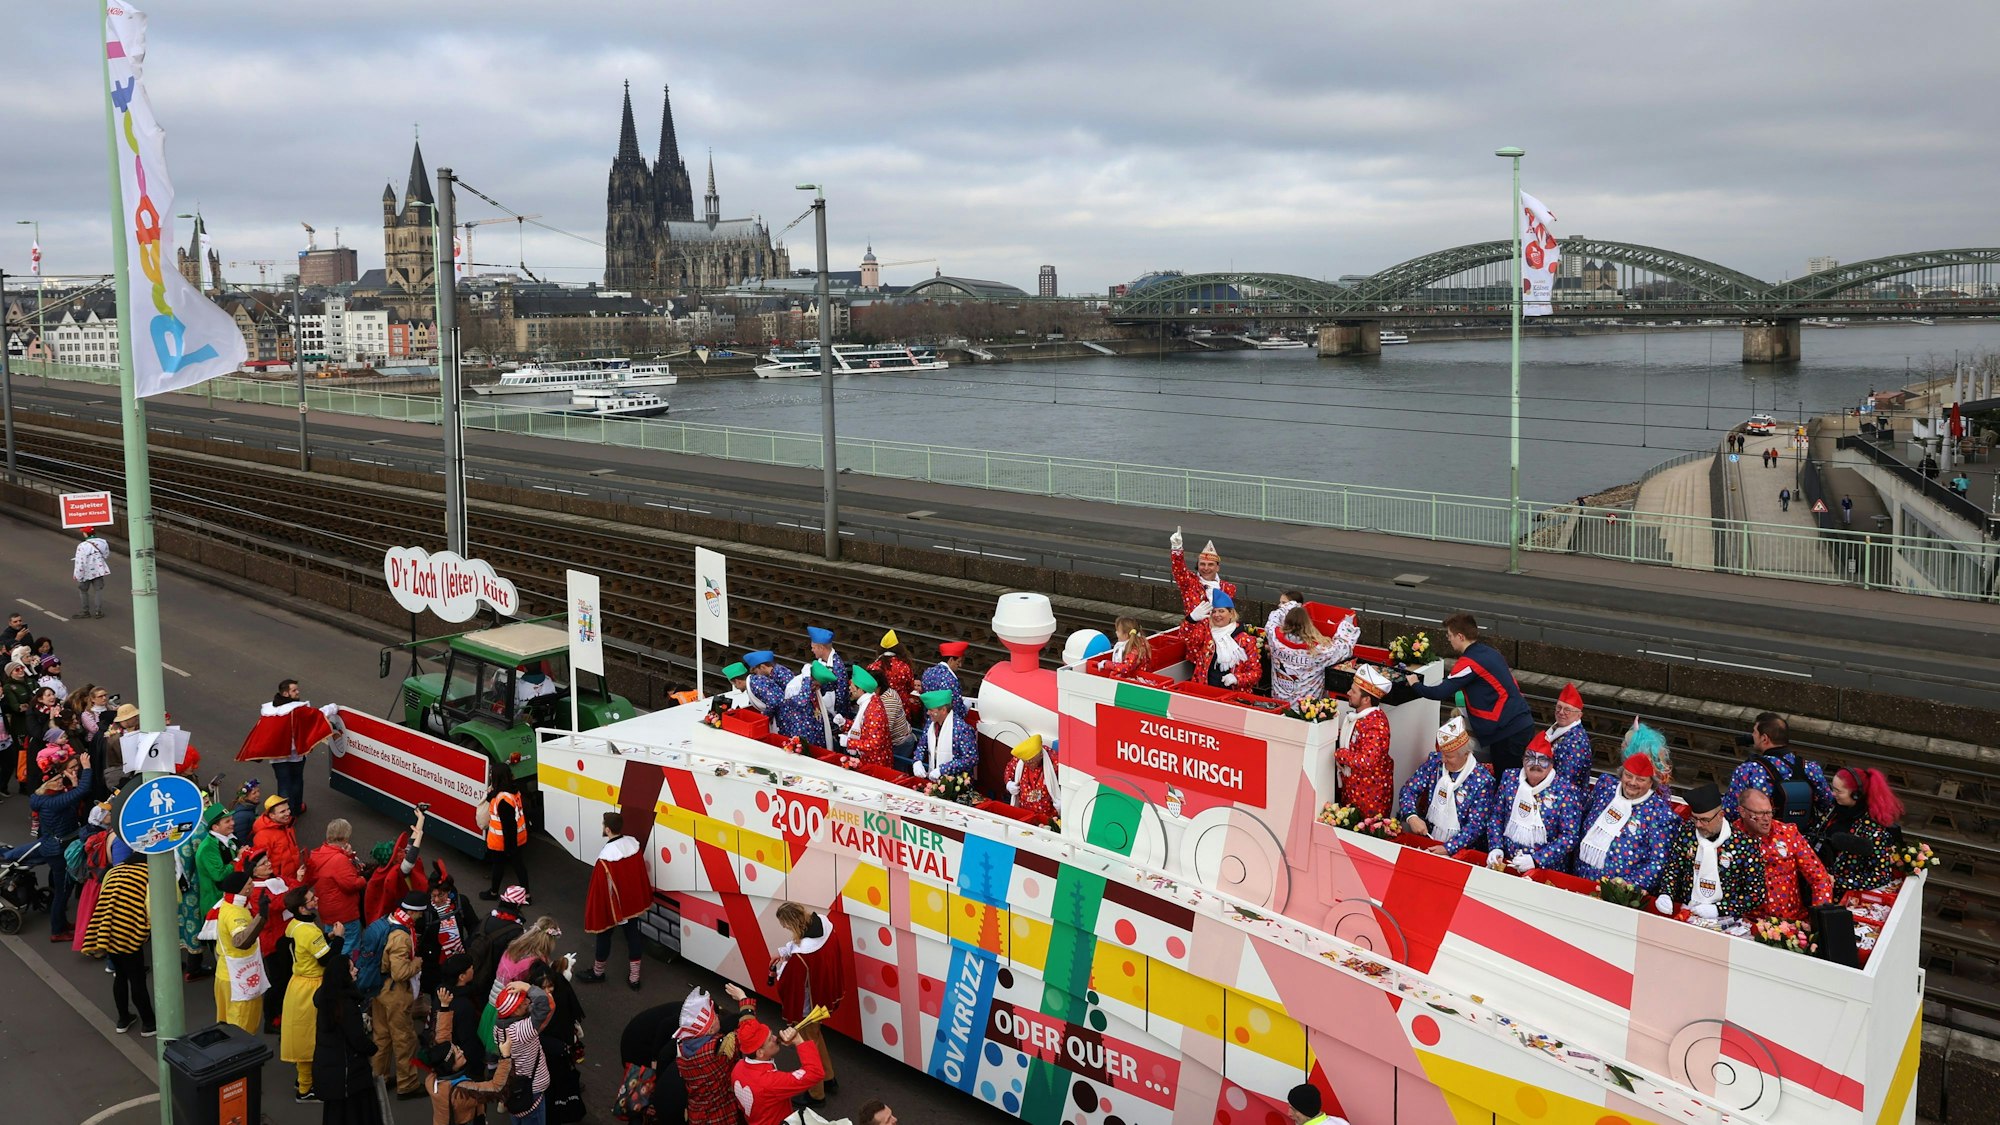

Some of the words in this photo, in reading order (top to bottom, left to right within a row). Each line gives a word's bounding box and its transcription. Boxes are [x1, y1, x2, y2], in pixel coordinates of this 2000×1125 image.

[391, 557, 408, 591] D'r
[412, 559, 438, 599] Zoch
[441, 562, 478, 607] (leiter)
[482, 575, 509, 608] kütt
[148, 743, 159, 758] 6
[521, 735, 533, 745] 56
[1140, 720, 1220, 751] ZUGLEITER:
[380, 750, 391, 763] des
[391, 753, 412, 772] Kölner
[412, 762, 443, 785] Karnevals
[444, 777, 456, 790] von
[457, 781, 473, 797] 1823
[1116, 740, 1179, 774] HOLGER
[1182, 756, 1243, 790] KIRSCH
[772, 794, 825, 843] 200
[826, 806, 860, 827] JAHRE
[863, 809, 945, 854] KÖLNER
[831, 820, 954, 883] KARNEVAL
[950, 951, 985, 1044] KRÜZZ
[943, 1039, 965, 1083] OV
[994, 1009, 1062, 1055] ODER
[1066, 1035, 1139, 1084] QUER
